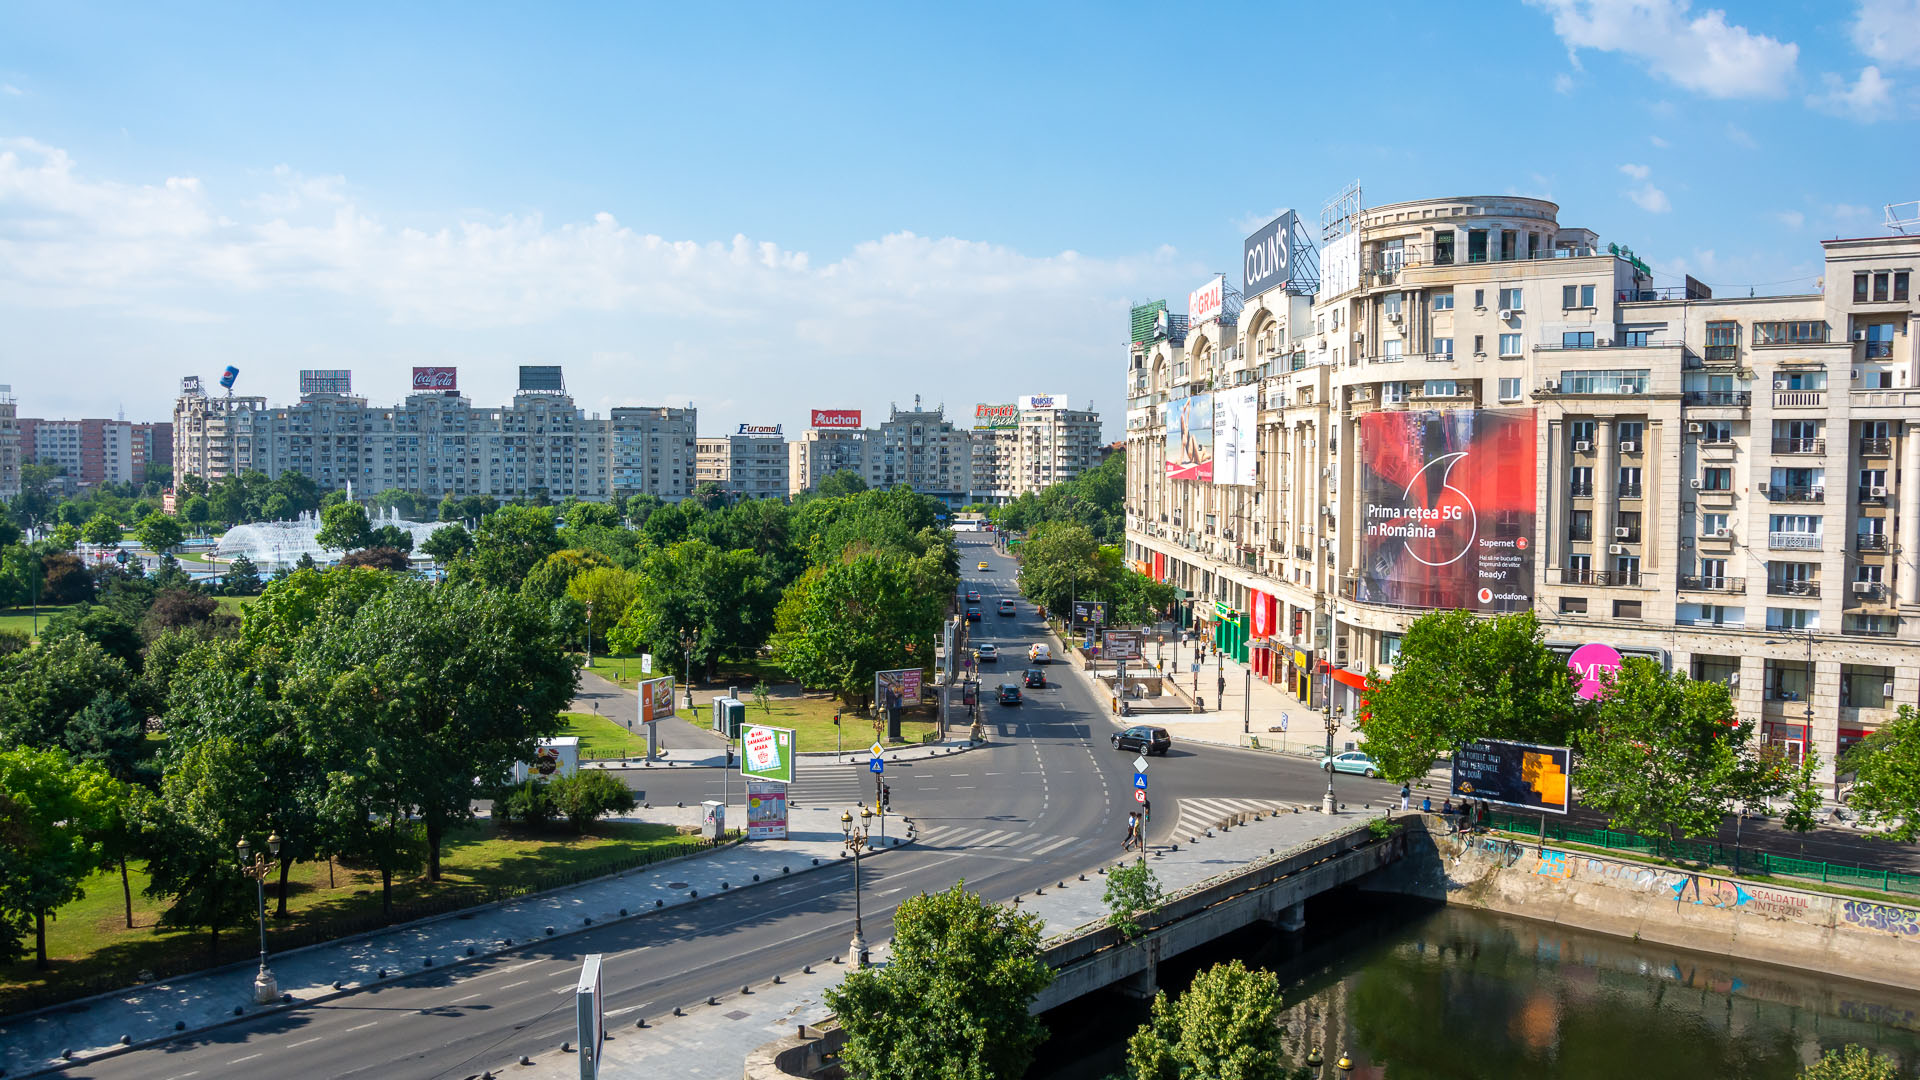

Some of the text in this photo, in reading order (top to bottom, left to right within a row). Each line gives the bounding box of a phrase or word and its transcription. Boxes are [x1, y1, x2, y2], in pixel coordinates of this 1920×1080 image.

[1246, 223, 1287, 286] COLIN'S
[413, 371, 455, 386] CocaCola
[976, 404, 1014, 417] Frutti
[815, 412, 859, 425] Auchan
[990, 411, 1019, 428] Fresh
[737, 423, 783, 435] Euromall
[1368, 503, 1401, 519] Prima
[1442, 505, 1462, 520] 5G
[1367, 521, 1436, 538] în România
[1479, 538, 1515, 548] Supernet
[1478, 570, 1507, 580] Ready?
[1494, 592, 1528, 601] vodafone
[1751, 889, 1809, 909] SCALDATUL
[1754, 900, 1803, 918] INTERZIS
